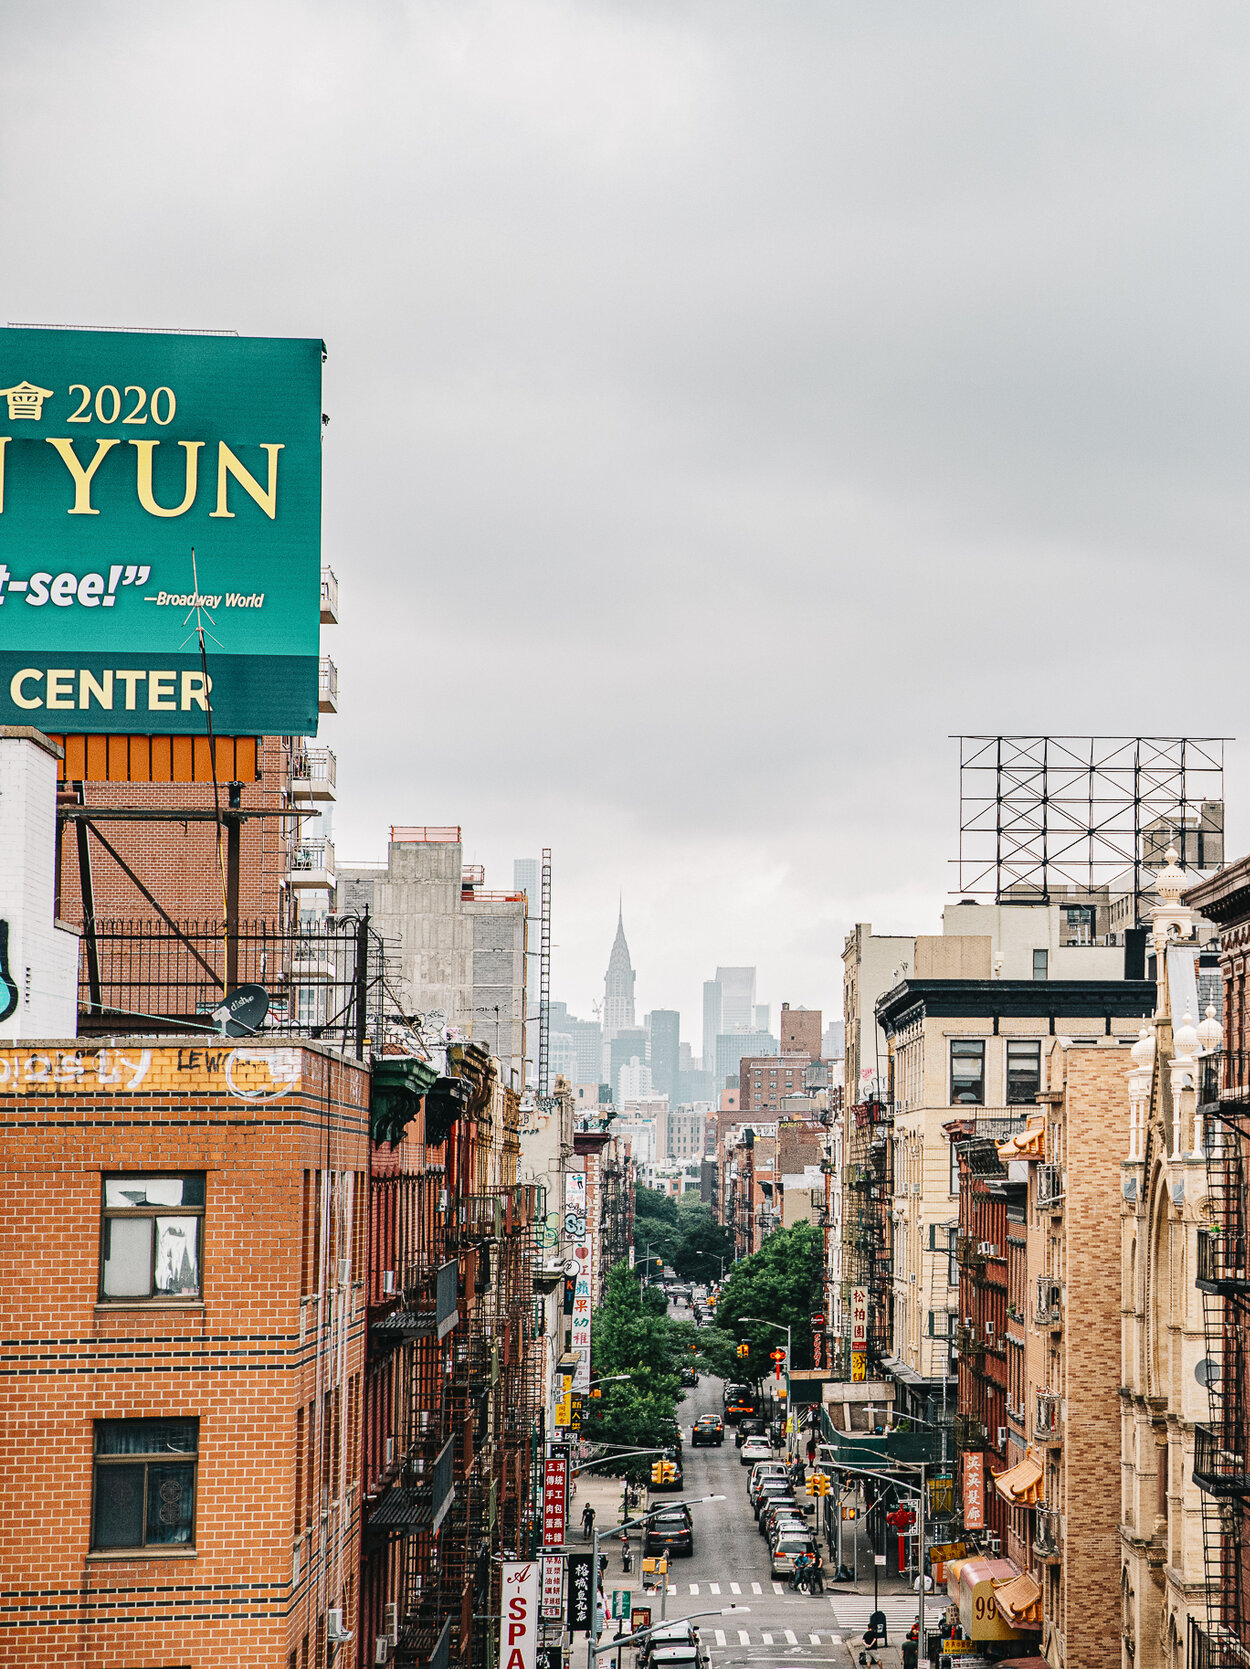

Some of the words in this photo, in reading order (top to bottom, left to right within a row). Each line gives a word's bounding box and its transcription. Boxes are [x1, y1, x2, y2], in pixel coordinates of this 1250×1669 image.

[0, 380, 54, 421] 會
[66, 384, 177, 426] 2020
[46, 437, 285, 520] YUN
[225, 592, 264, 608] World
[10, 668, 213, 711] CENTER
[231, 996, 247, 1012] dish
[546, 1489, 563, 1500] 手工
